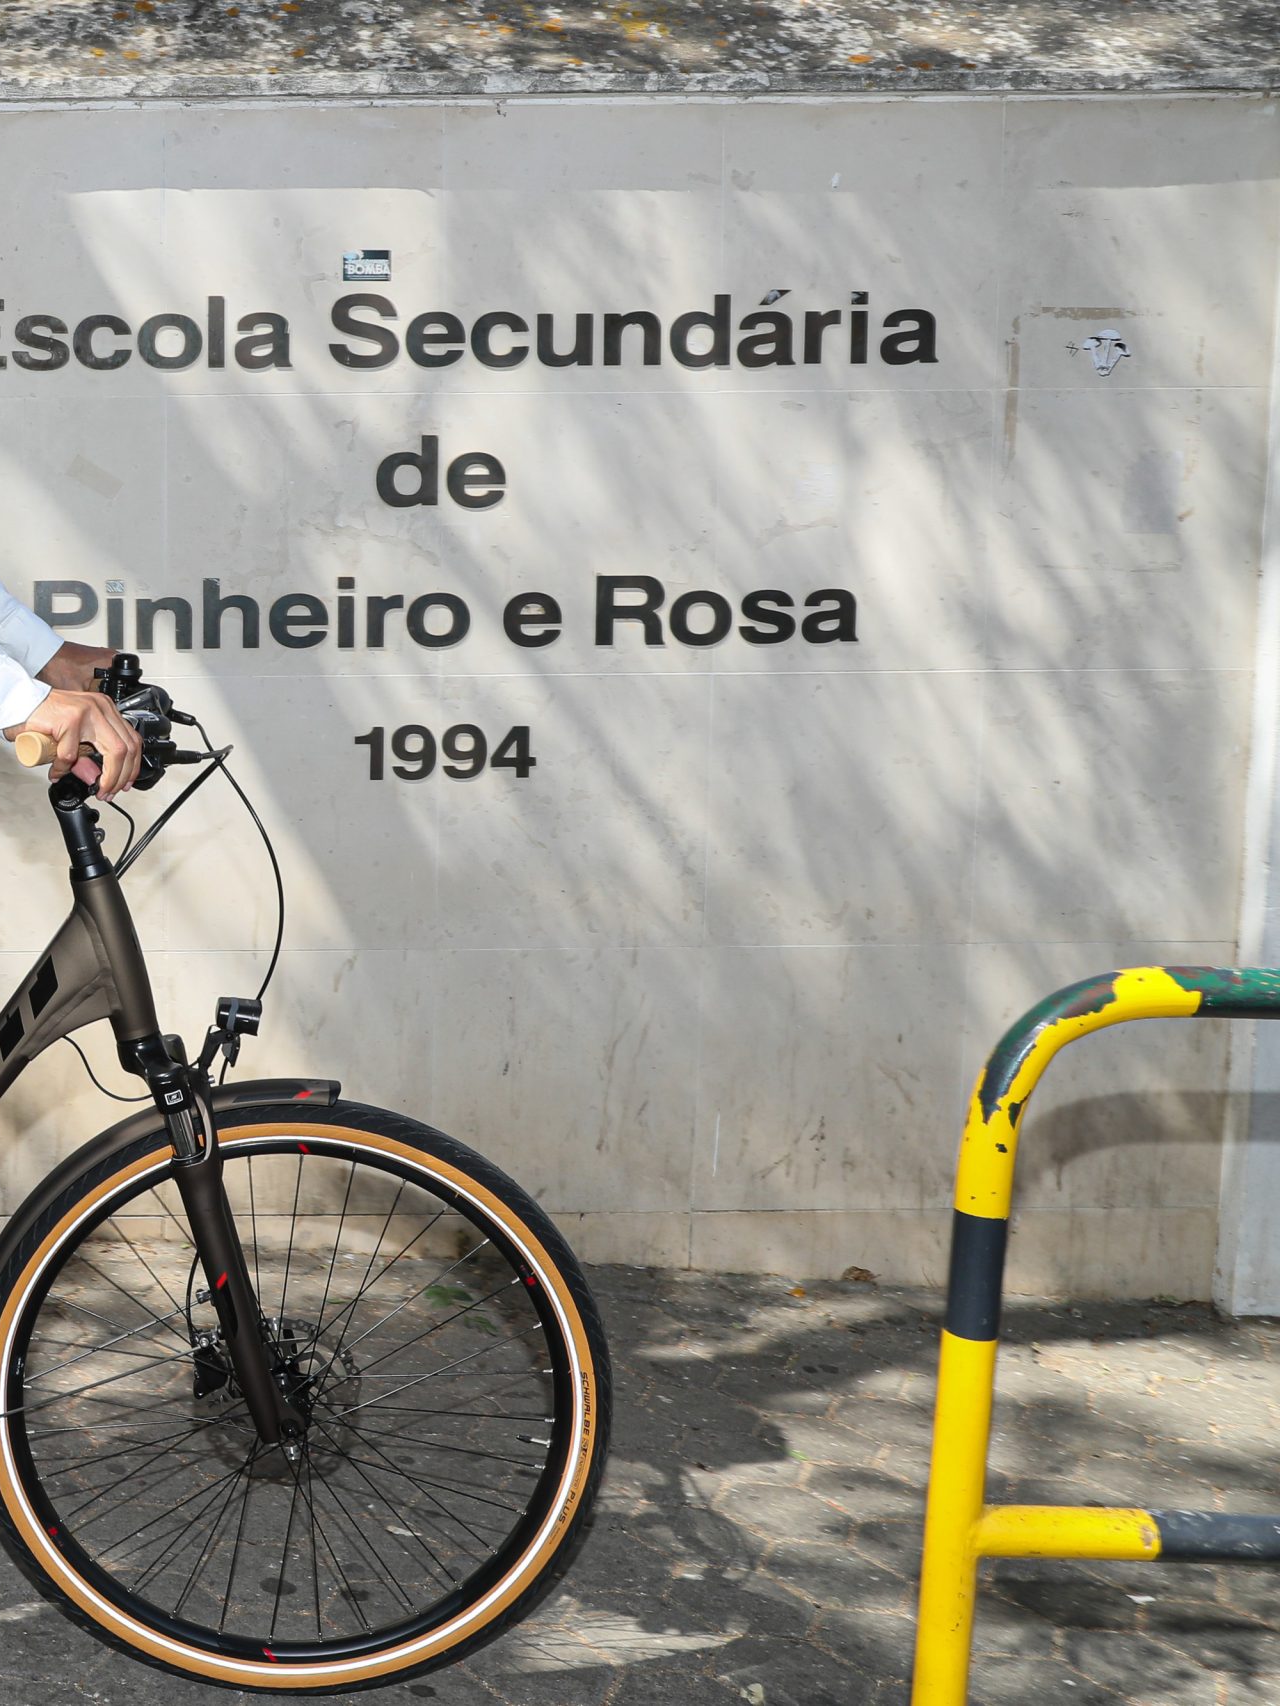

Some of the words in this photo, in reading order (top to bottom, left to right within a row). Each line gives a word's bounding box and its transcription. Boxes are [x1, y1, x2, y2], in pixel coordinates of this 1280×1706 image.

[328, 289, 939, 369] Secundária
[375, 434, 506, 509] de
[34, 577, 471, 650] Pinheiro
[502, 591, 563, 648] e
[594, 575, 859, 647] Rosa
[354, 723, 537, 781] 1994
[580, 1371, 591, 1436] SCHWALBE
[558, 1490, 577, 1525] PLUS
